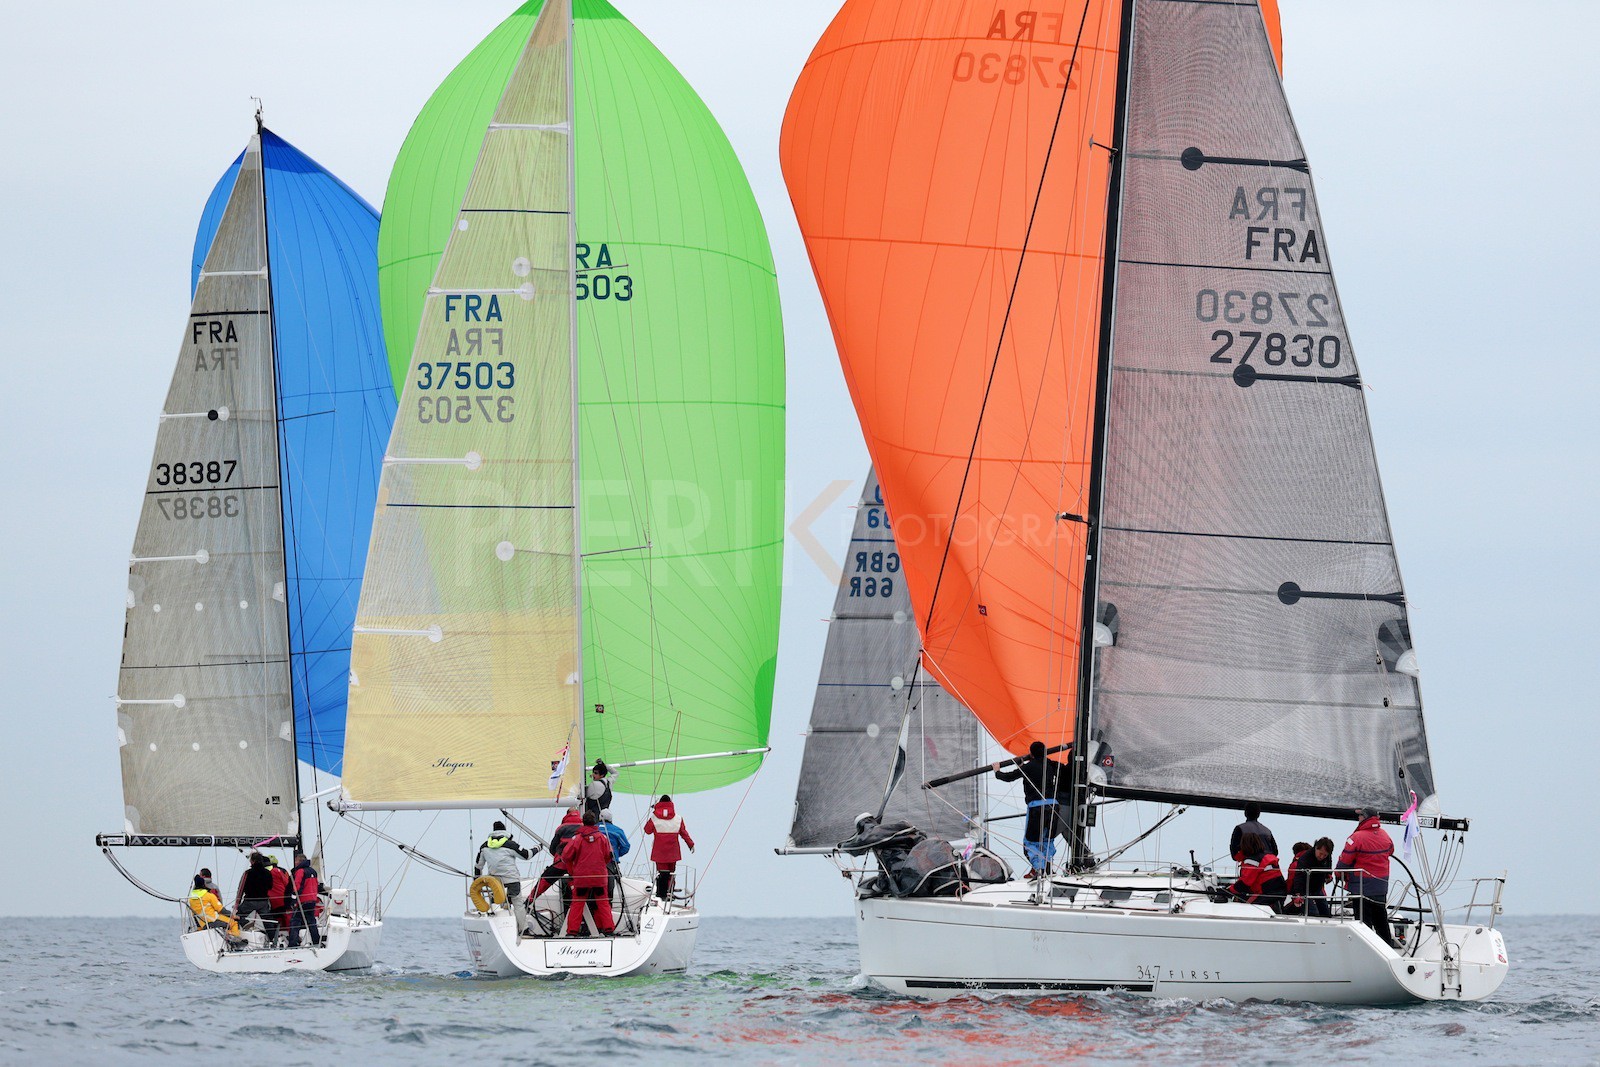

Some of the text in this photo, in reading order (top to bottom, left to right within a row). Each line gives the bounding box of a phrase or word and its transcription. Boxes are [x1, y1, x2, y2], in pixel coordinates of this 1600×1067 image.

[575, 243, 613, 270] RA
[1245, 226, 1322, 264] FRA
[575, 274, 633, 302] 503
[445, 294, 503, 322] FRA
[193, 319, 238, 345] FRA
[1210, 329, 1341, 369] 27830
[417, 361, 515, 390] 37503
[156, 459, 238, 486] 38387
[130, 836, 191, 846] AXXON
[1169, 970, 1222, 980] FIRST
